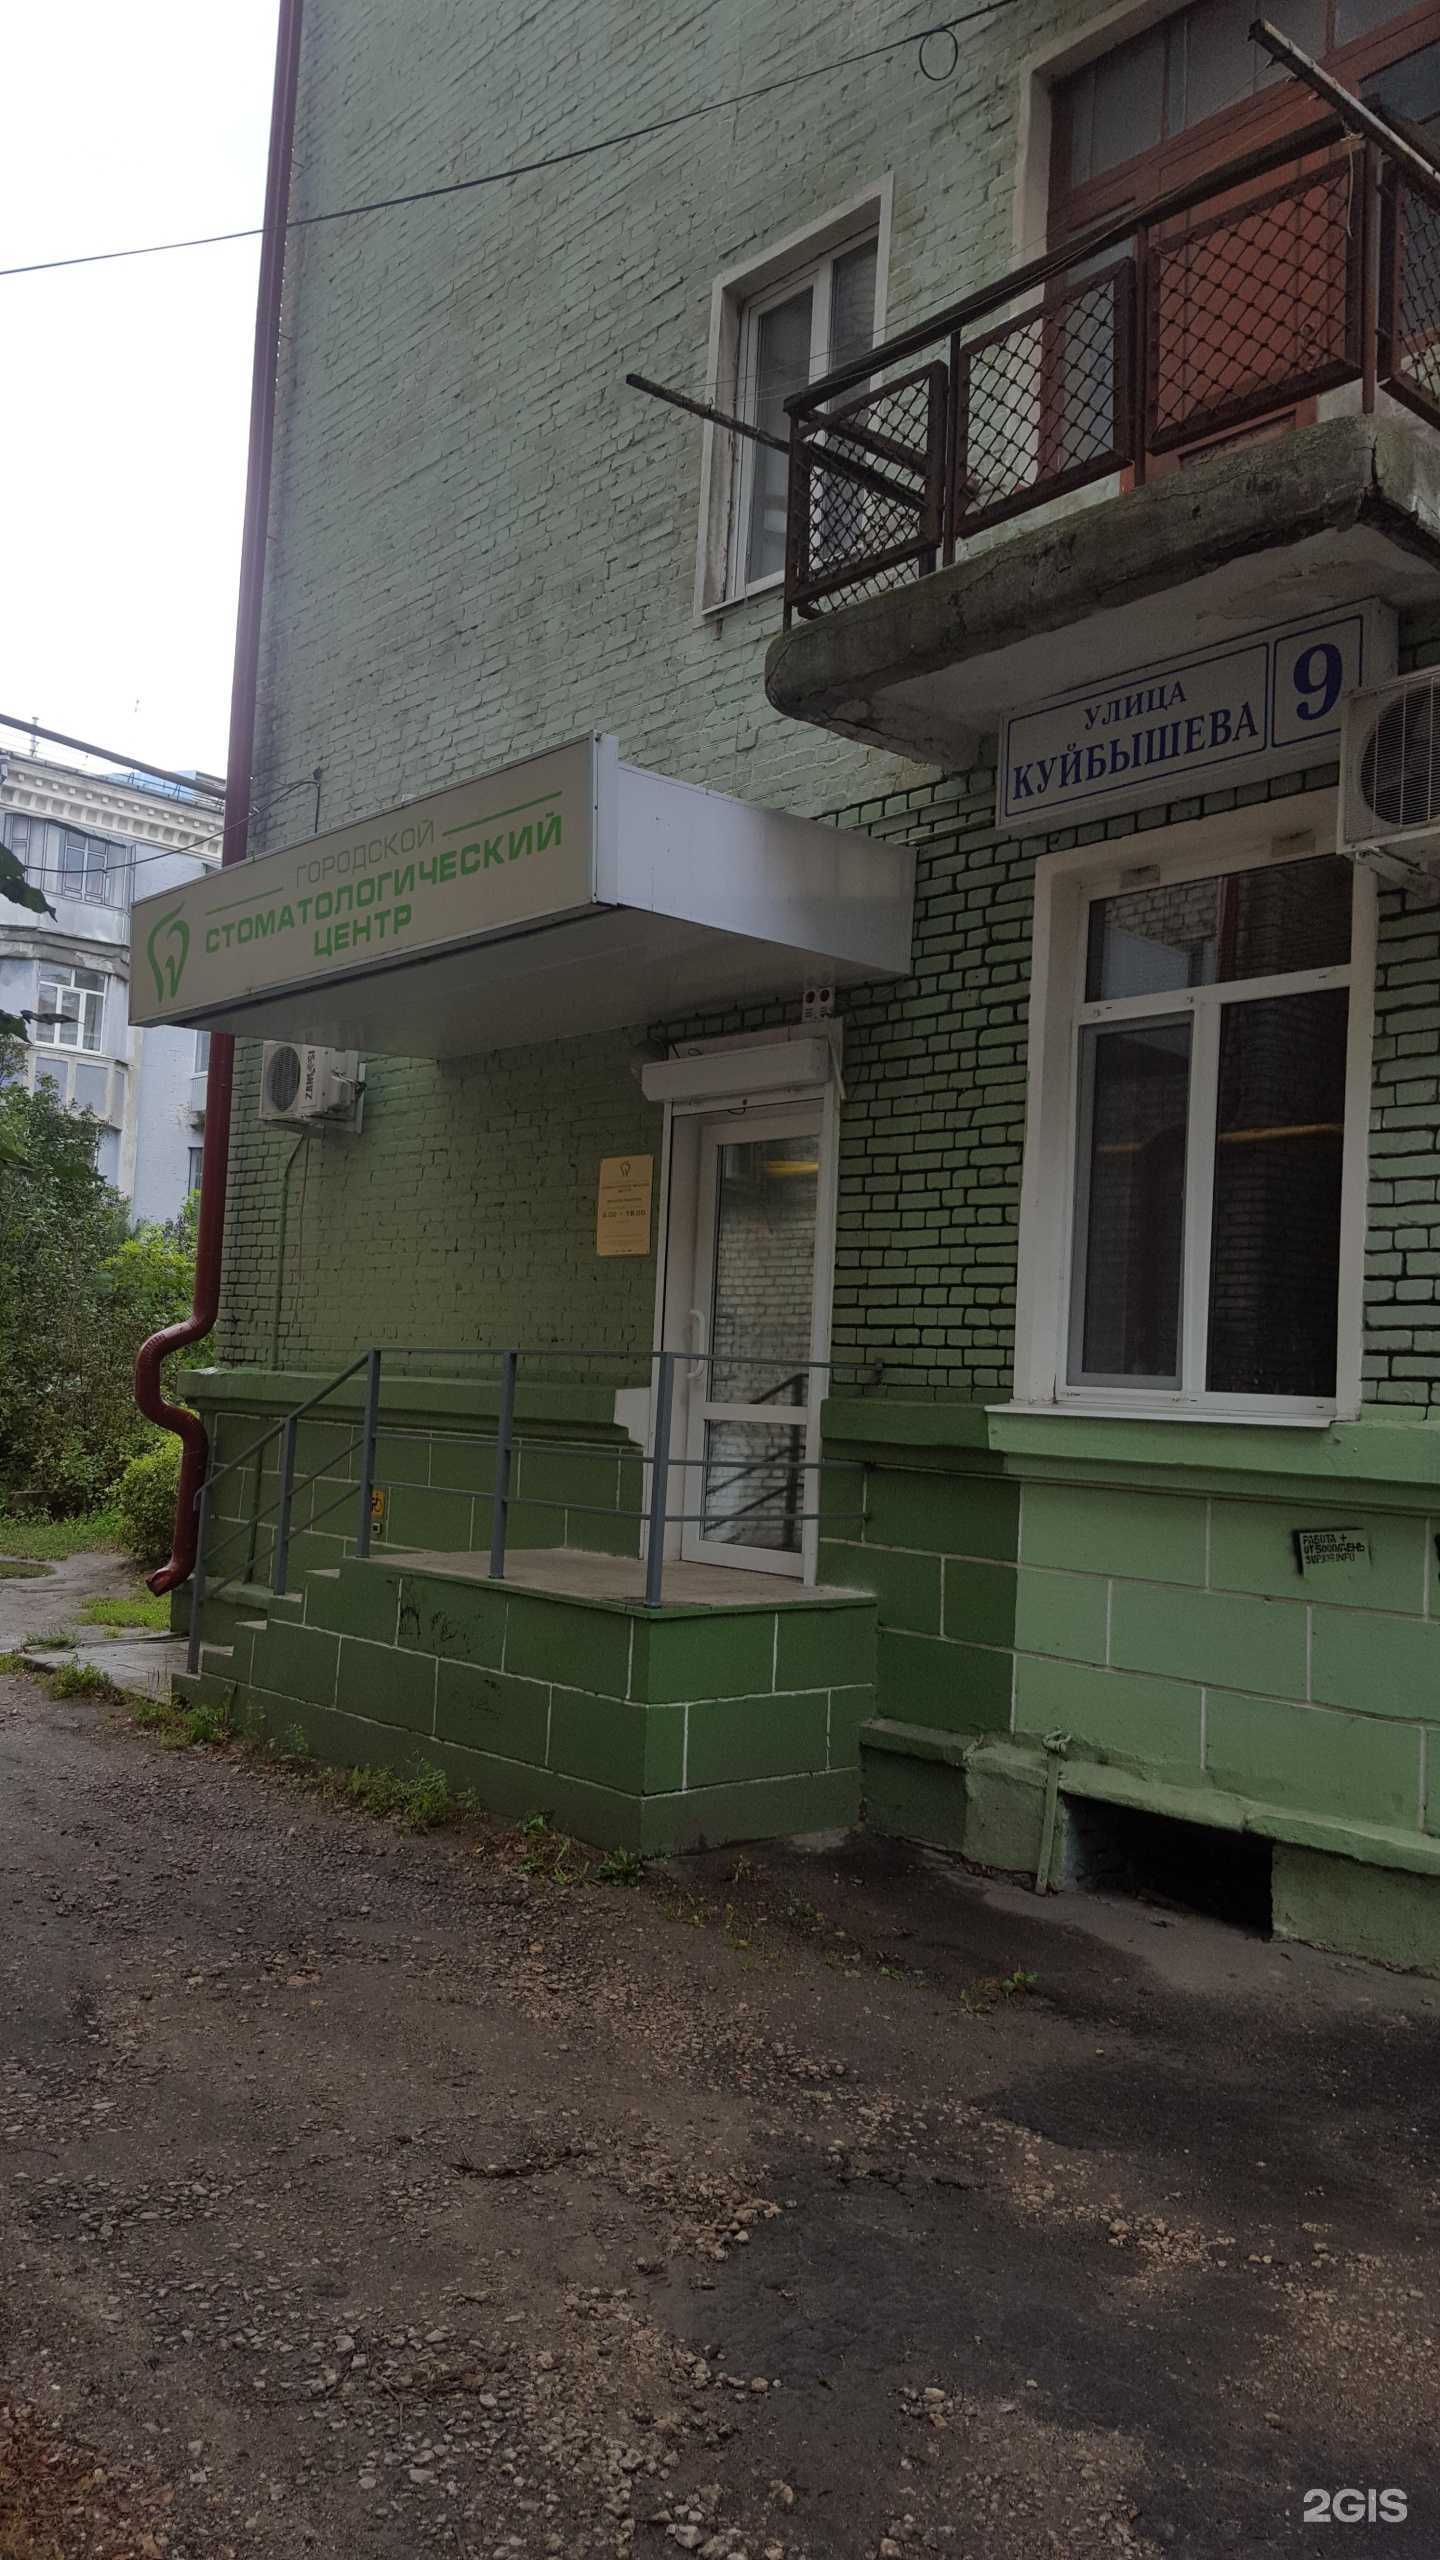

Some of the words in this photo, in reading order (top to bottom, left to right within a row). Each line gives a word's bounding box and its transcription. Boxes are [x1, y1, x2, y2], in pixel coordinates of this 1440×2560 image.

[1083, 681, 1187, 731] УЛИЦА
[1292, 643, 1343, 721] 9
[1012, 702, 1260, 800] КУЙБЫШЕВА
[205, 811, 563, 954] СТОМАТОЛОГИЧЕСКИЙ
[296, 819, 435, 889] ГОРОДСКОЙ
[314, 903, 412, 957] ЦЕНТР
